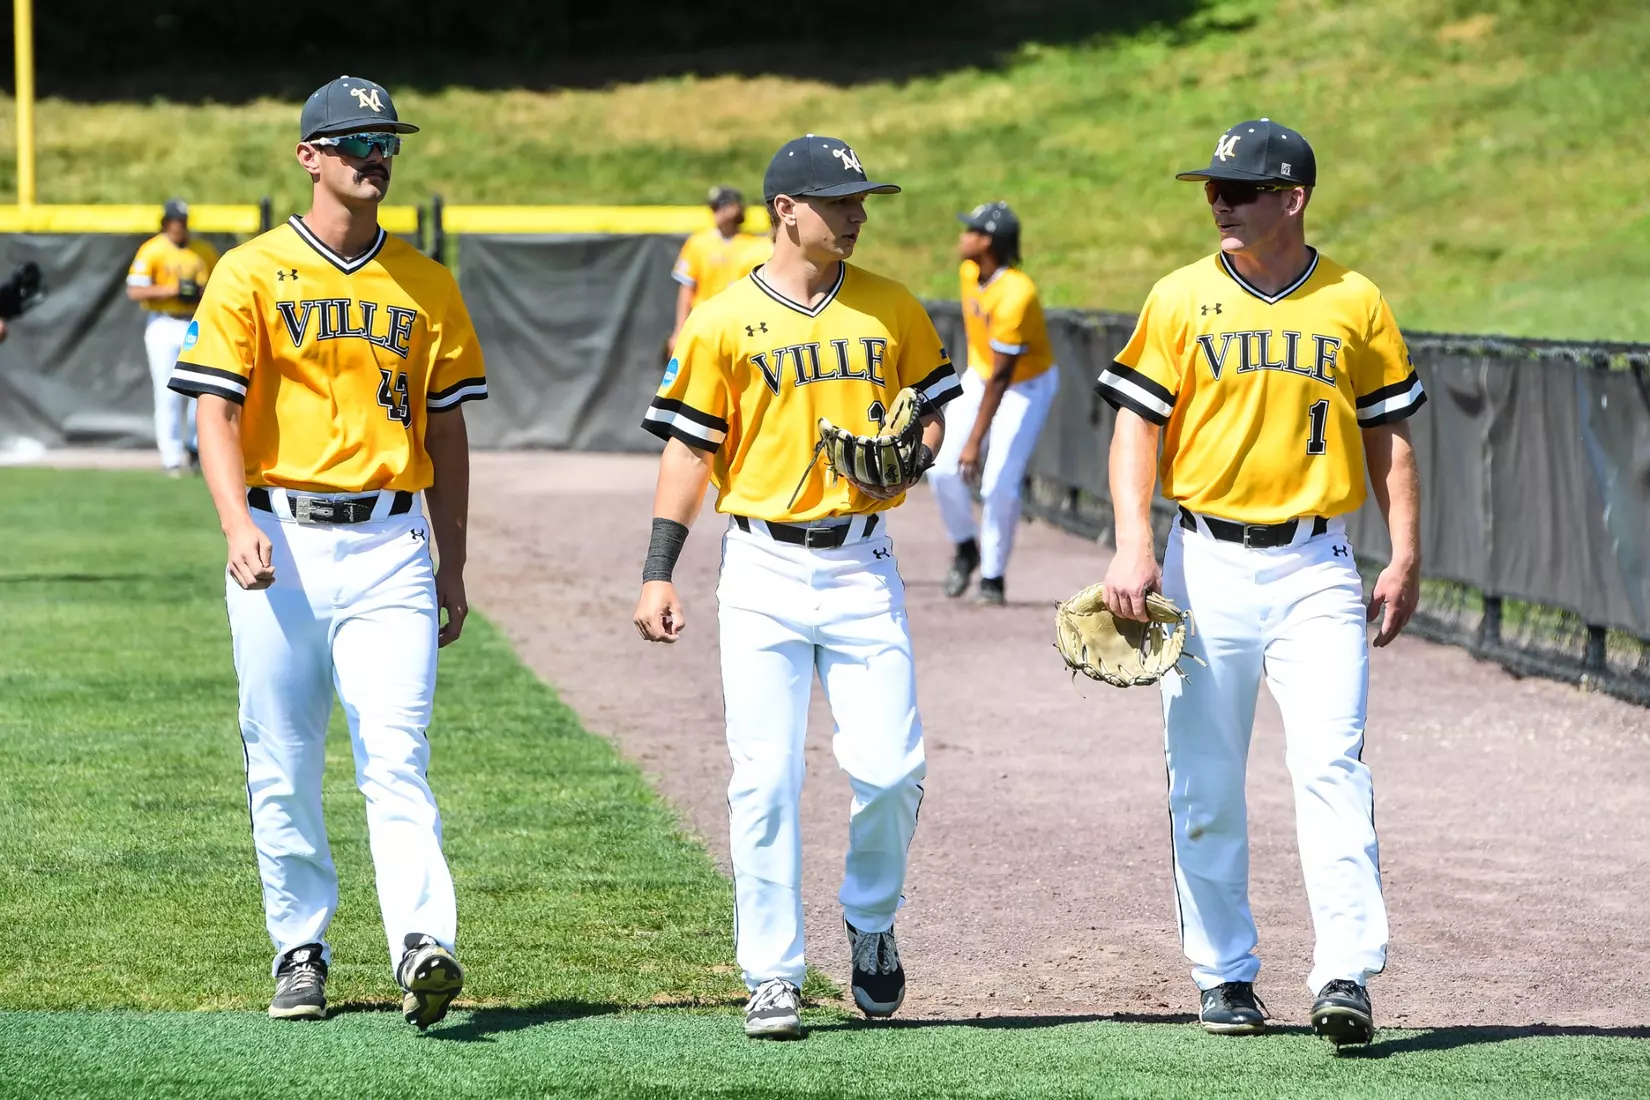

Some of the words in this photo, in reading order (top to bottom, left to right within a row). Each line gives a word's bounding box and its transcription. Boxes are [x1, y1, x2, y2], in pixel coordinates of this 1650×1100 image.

[276, 298, 417, 359] VILLE
[750, 337, 887, 396] VILLE
[1197, 330, 1341, 388] VILLE
[376, 367, 412, 429] 43
[1306, 398, 1330, 455] 1
